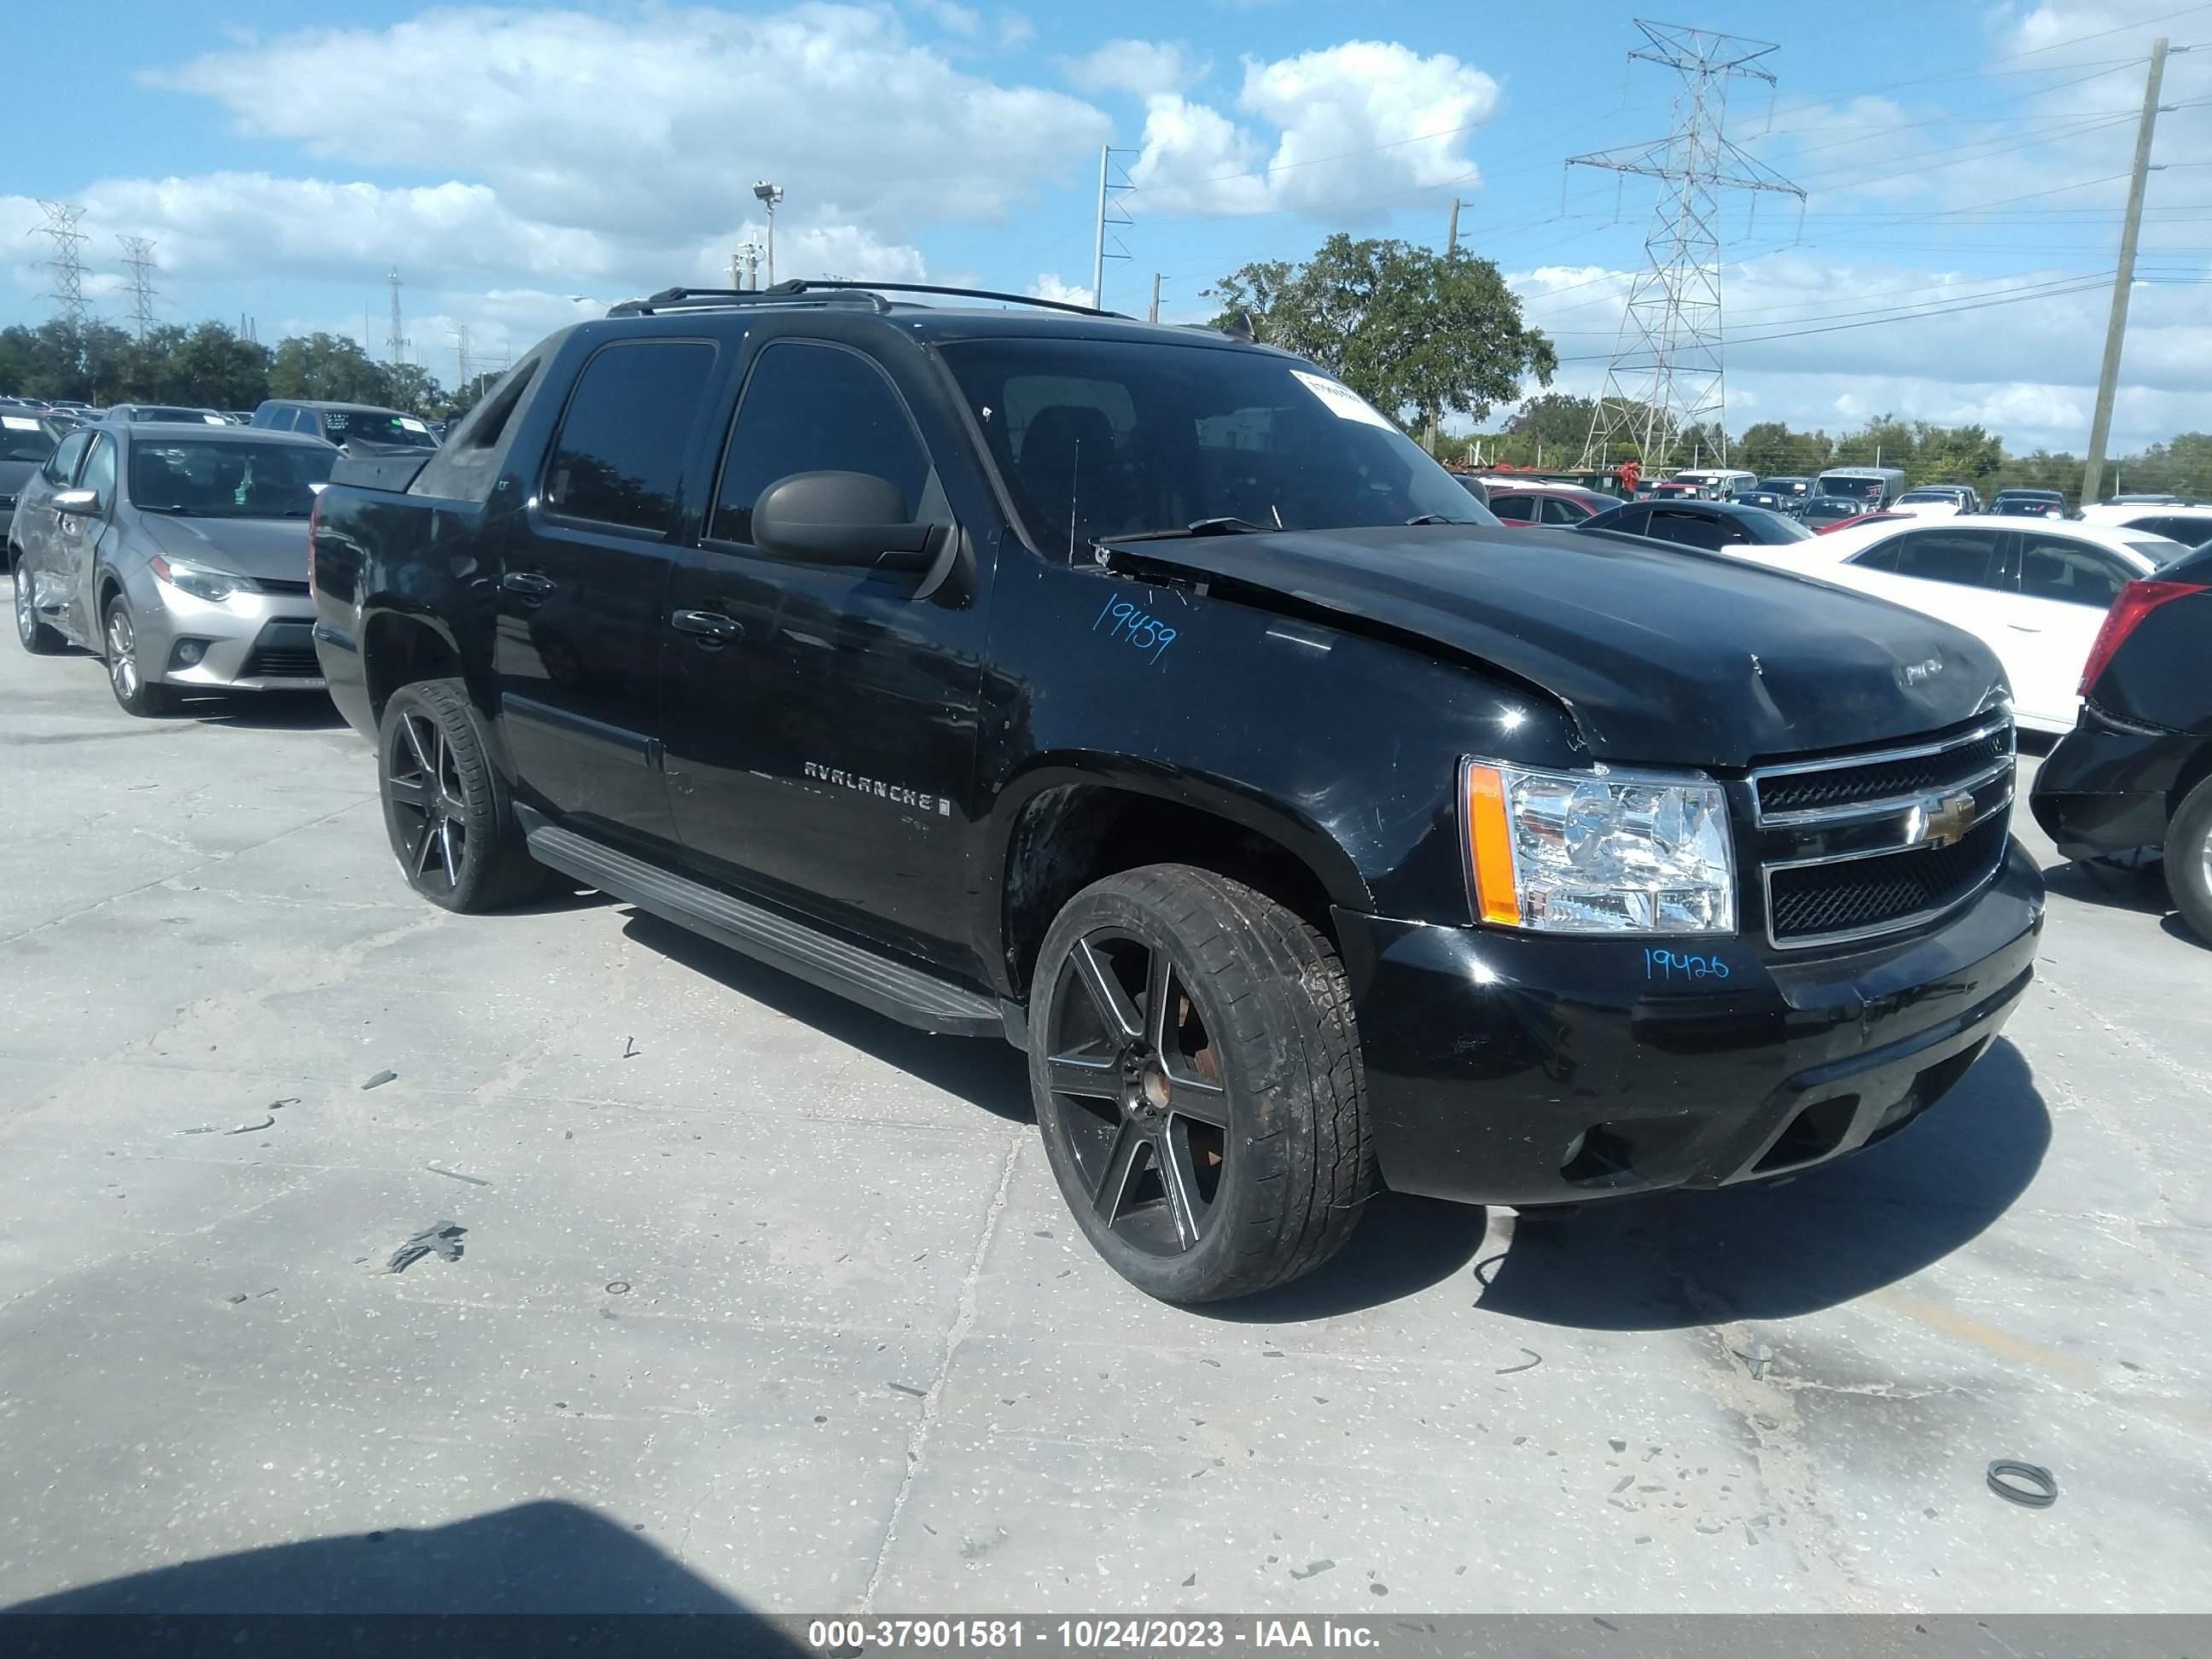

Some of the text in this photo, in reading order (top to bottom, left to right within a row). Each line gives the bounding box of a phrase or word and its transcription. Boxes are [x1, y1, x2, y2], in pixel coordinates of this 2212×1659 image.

[1092, 593, 1177, 666] 19459
[804, 761, 933, 811] AVALANCHE
[1644, 947, 1730, 981] 19426
